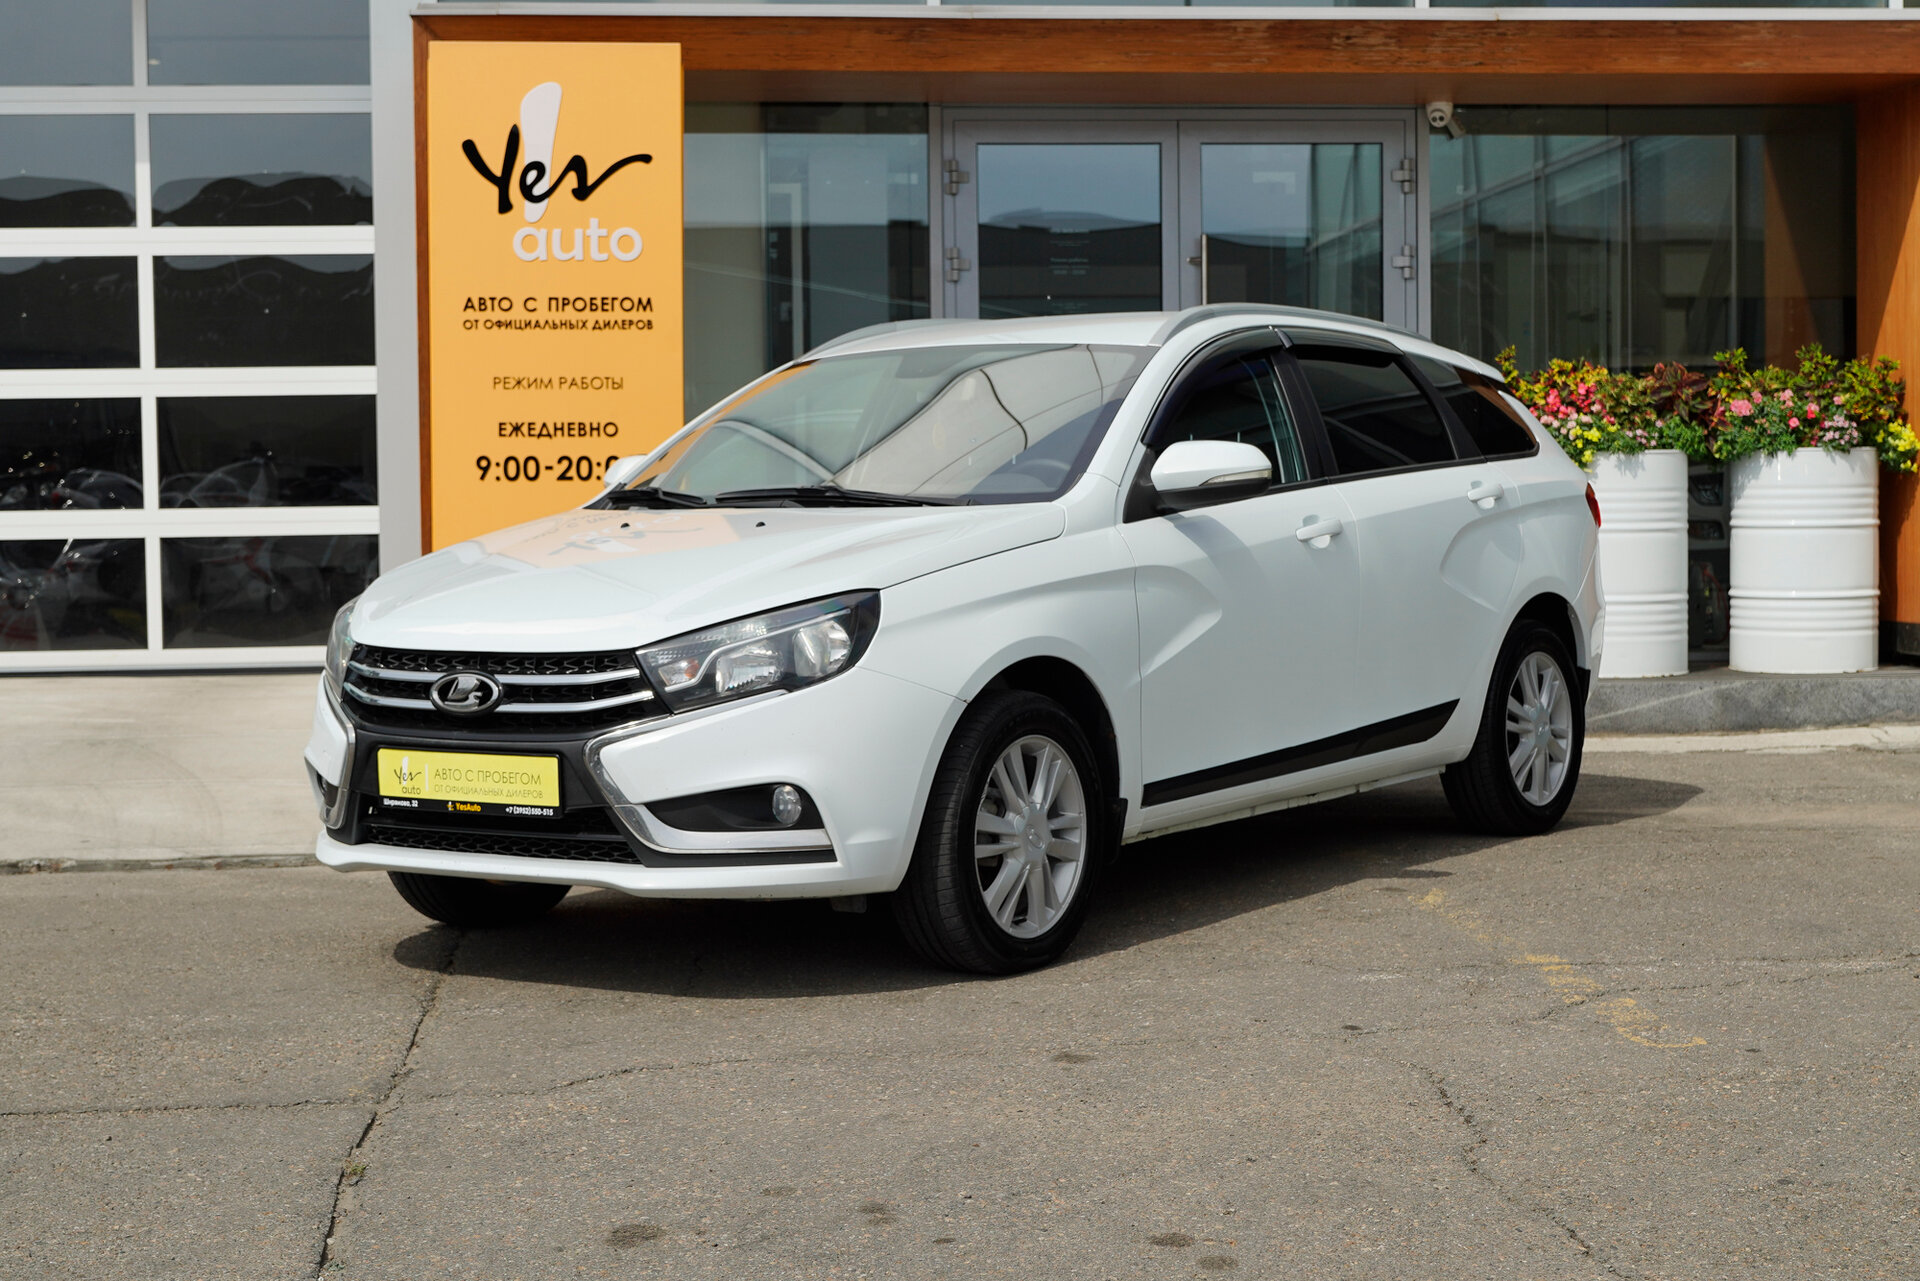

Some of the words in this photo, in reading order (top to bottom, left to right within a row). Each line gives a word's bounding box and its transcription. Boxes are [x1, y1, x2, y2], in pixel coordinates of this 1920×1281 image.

[462, 124, 652, 214] Yes
[513, 218, 643, 261] auto
[463, 297, 513, 312] АВТО
[523, 297, 538, 312] С
[548, 297, 653, 312] ПРОБЕГОМ
[463, 320, 479, 330] ОТ
[484, 320, 588, 331] ОФИЦИАЛЬНЫХ
[592, 320, 653, 331] ДИЛЕРОВ
[493, 376, 553, 390] РЕЖИМ
[559, 376, 624, 390] РАБОТЫ
[498, 422, 618, 438] ЕЖЕДНЕВНО
[394, 766, 422, 784] Yes
[434, 769, 462, 782] АВТО
[465, 770, 474, 782] С
[477, 770, 542, 785] ПРОБЕГОМ
[402, 785, 421, 795] auto
[434, 784, 444, 793] ОТ
[445, 785, 504, 797] ОФИЦИАЛЬНЫХ
[505, 789, 543, 799] ДИЛЕРОВ
[455, 803, 482, 812] YesAuto
